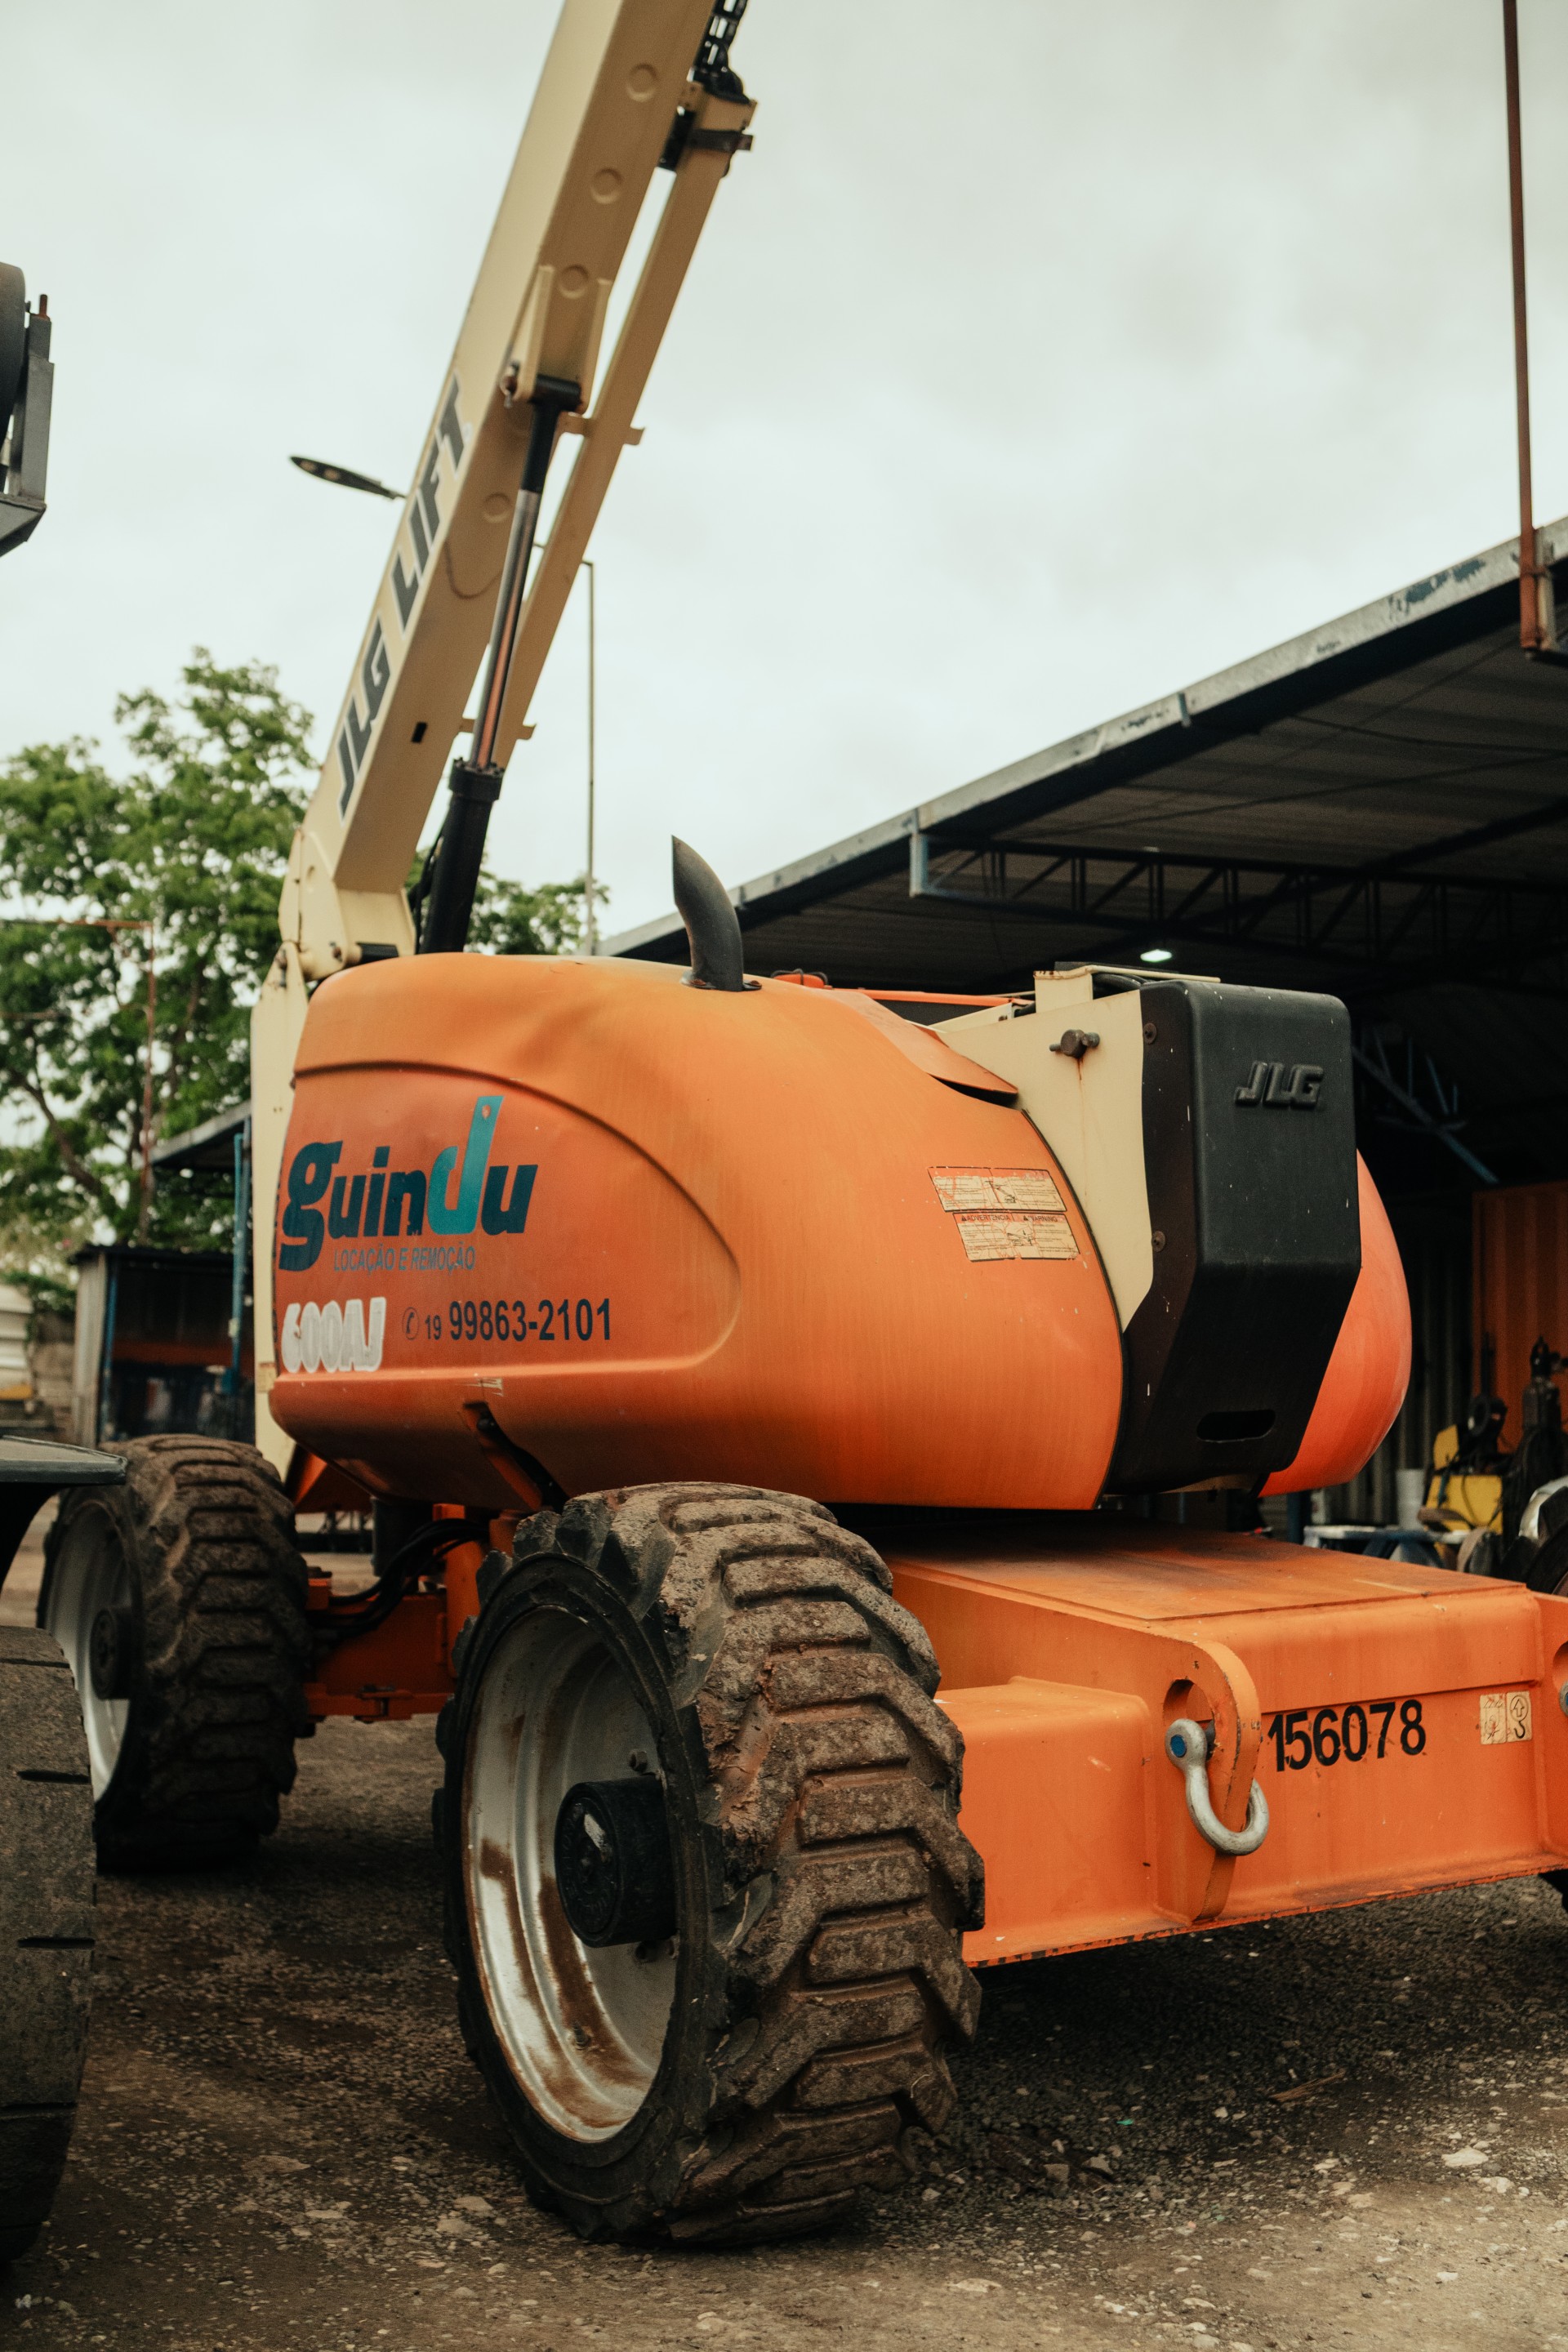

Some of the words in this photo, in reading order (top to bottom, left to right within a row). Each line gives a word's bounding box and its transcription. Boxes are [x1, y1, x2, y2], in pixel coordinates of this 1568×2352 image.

[336, 612, 390, 823] JLG
[391, 372, 465, 635] LIFT
[1234, 1061, 1324, 1108] JLG
[278, 1095, 538, 1272] guindu
[333, 1243, 395, 1275] LOCAÇÃO
[399, 1247, 408, 1271] E
[411, 1241, 476, 1275] REMOÇÃO
[425, 1314, 442, 1341] 19
[449, 1298, 610, 1342] 99863-2101
[1267, 1699, 1426, 1772] 156078
